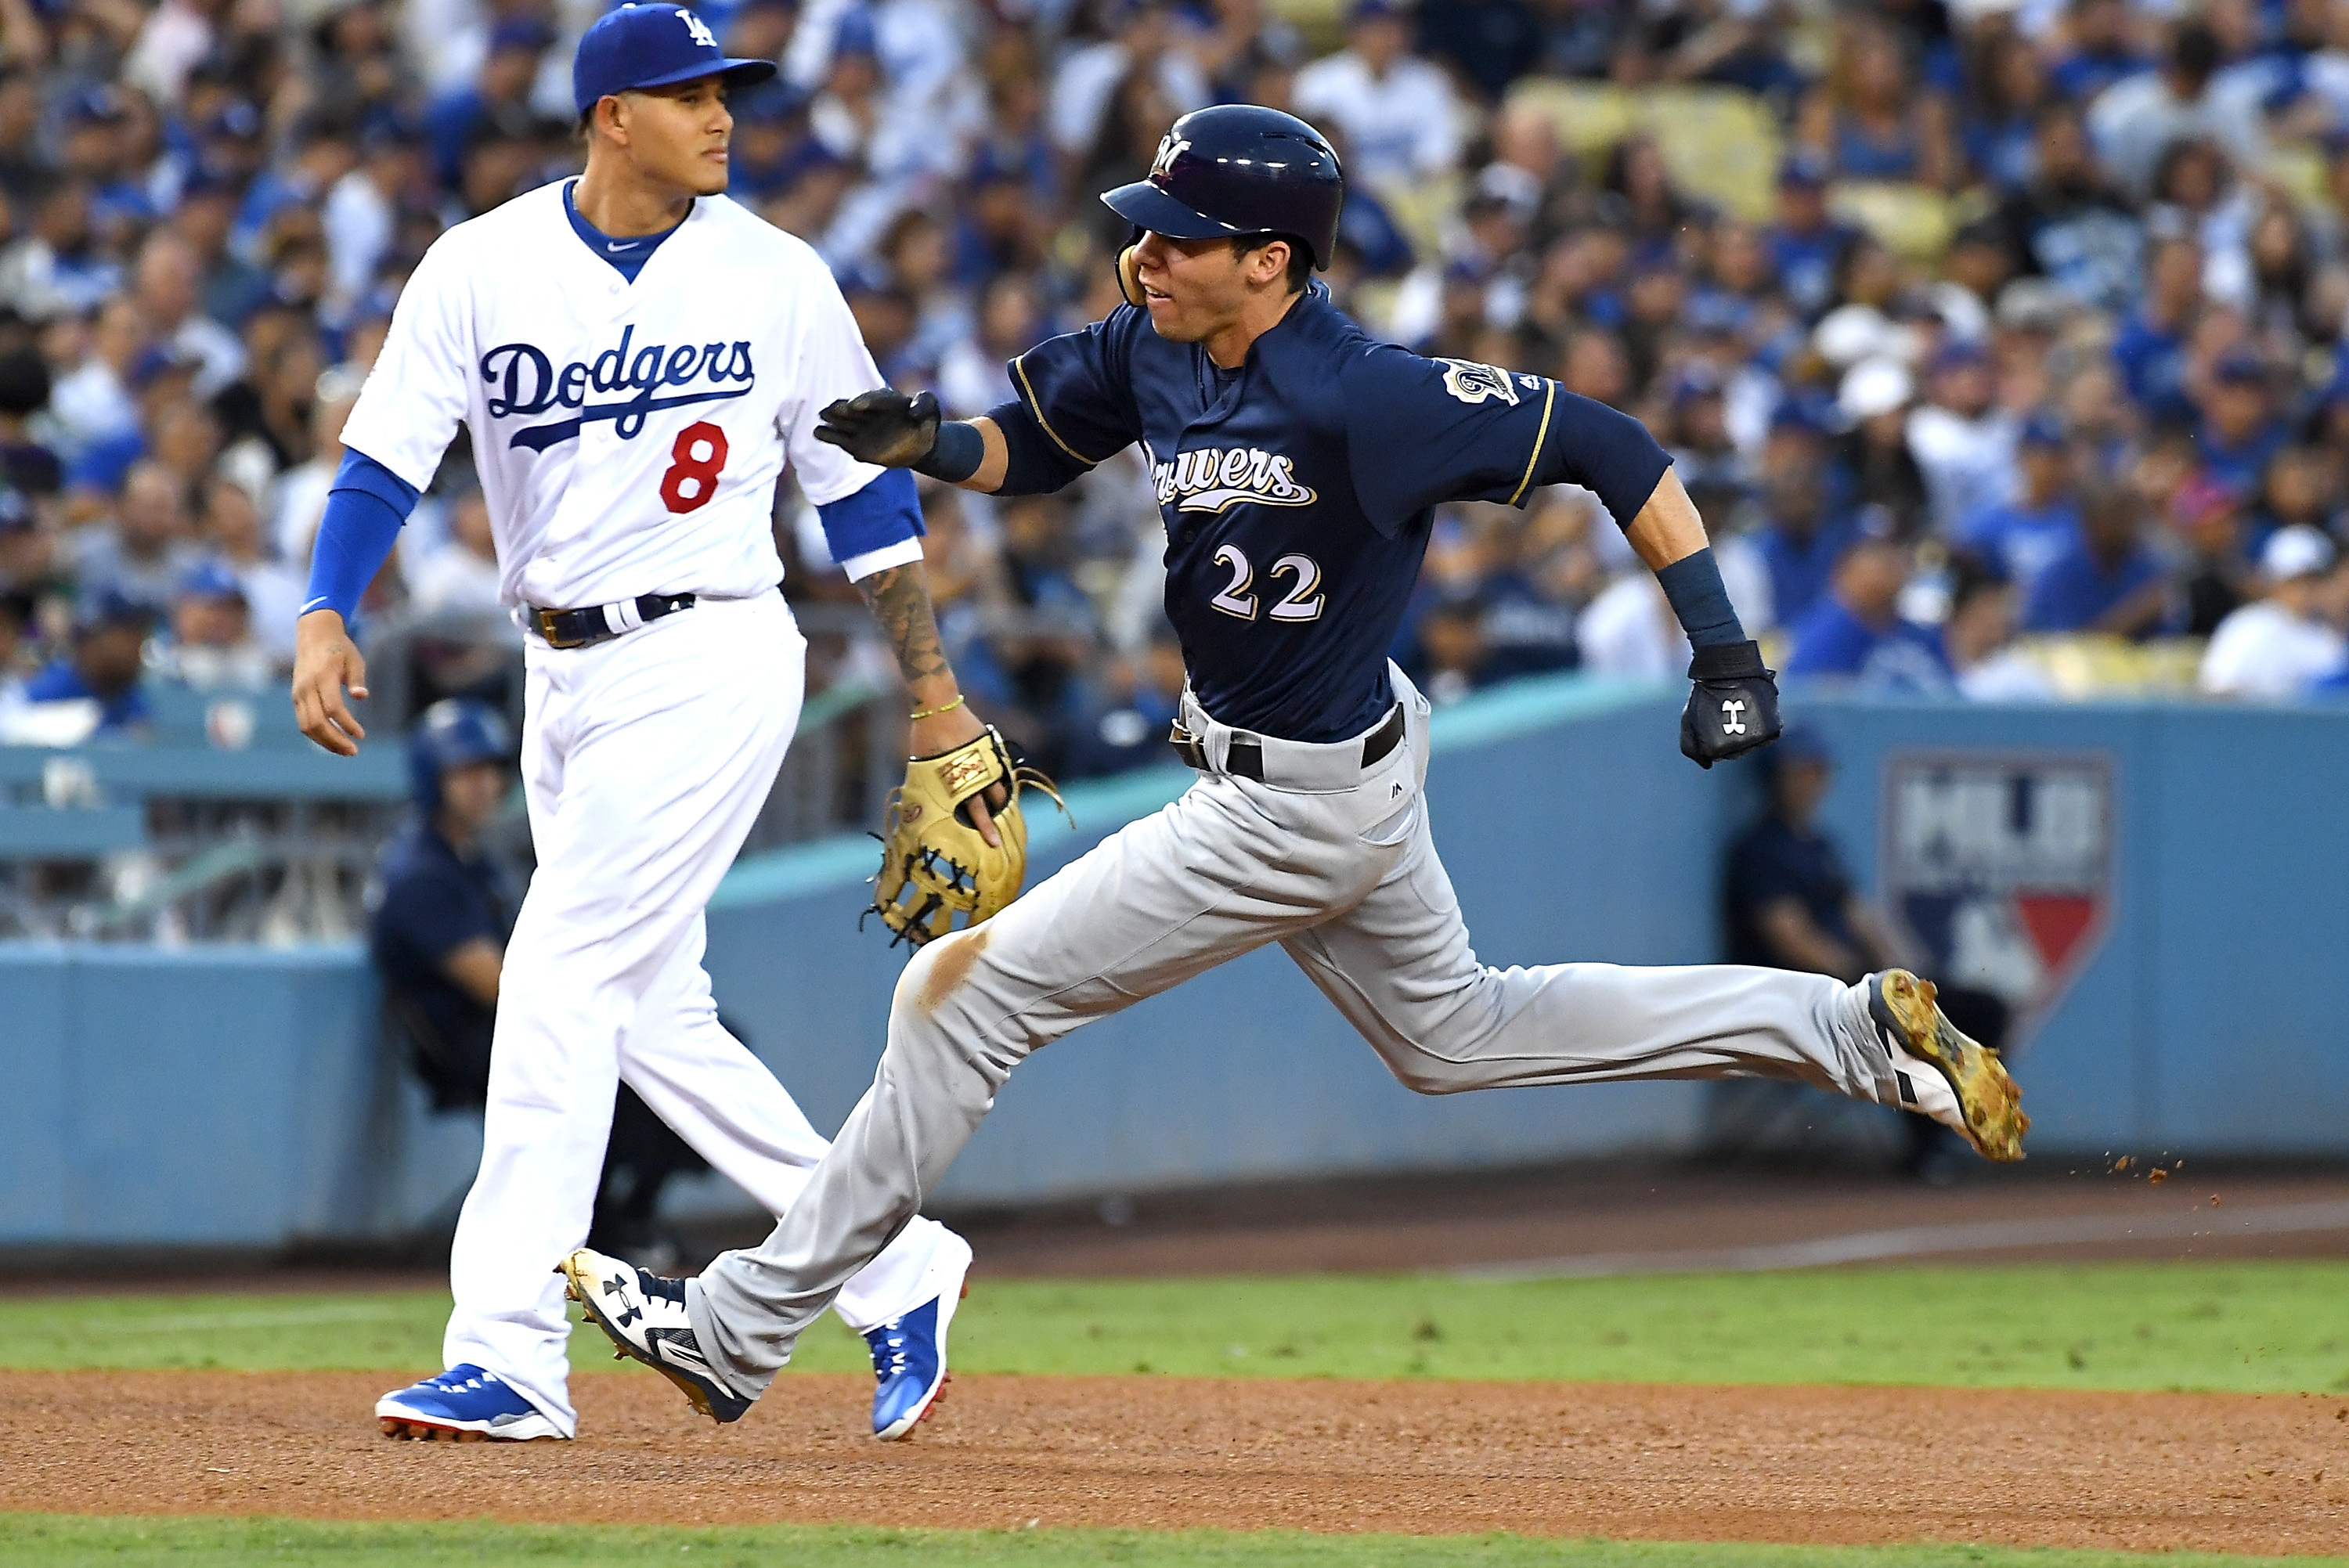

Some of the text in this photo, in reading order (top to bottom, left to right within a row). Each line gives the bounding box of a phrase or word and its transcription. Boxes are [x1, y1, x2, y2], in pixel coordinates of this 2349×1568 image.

[675, 9, 718, 47] LA
[480, 323, 755, 456] Dodgers
[659, 420, 729, 514] 8
[1211, 542, 1326, 622] 22
